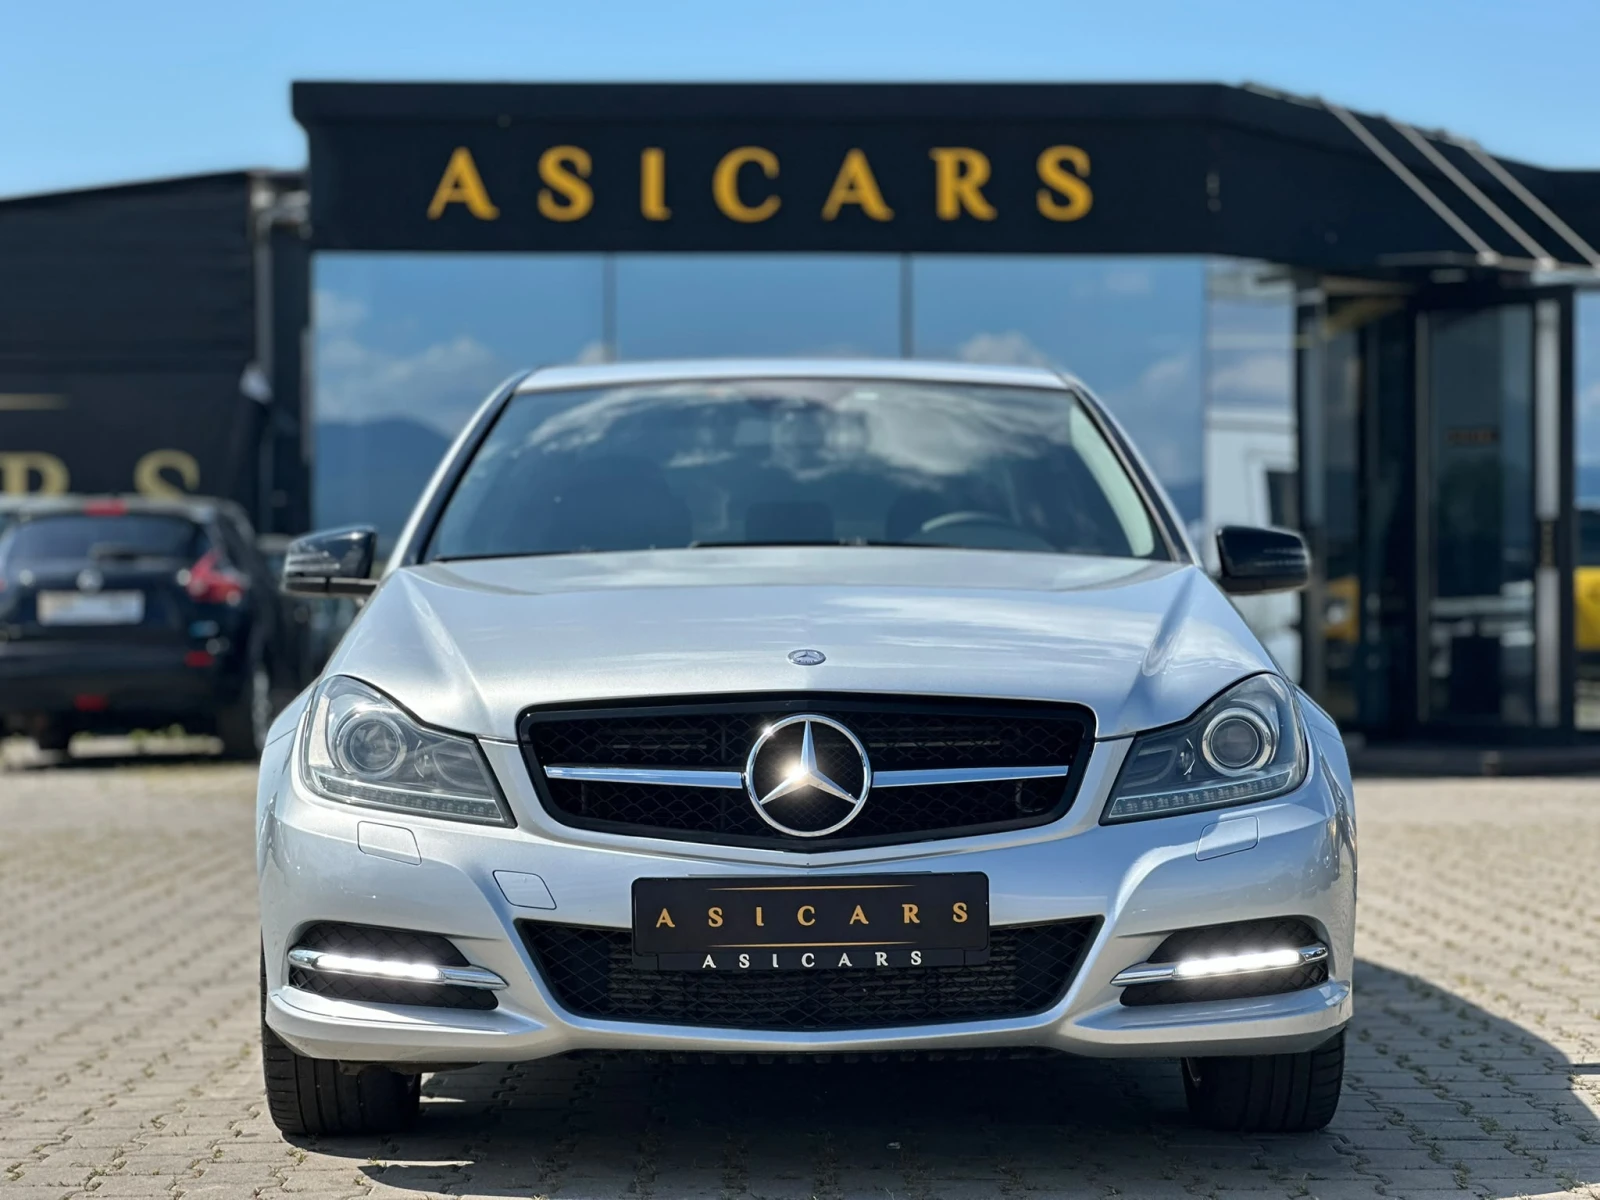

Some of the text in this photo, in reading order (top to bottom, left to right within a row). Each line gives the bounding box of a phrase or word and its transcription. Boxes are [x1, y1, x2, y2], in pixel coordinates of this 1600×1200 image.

[427, 145, 1094, 223] ASICARS
[655, 901, 969, 929] ASICARS
[702, 950, 922, 969] ASICARS
